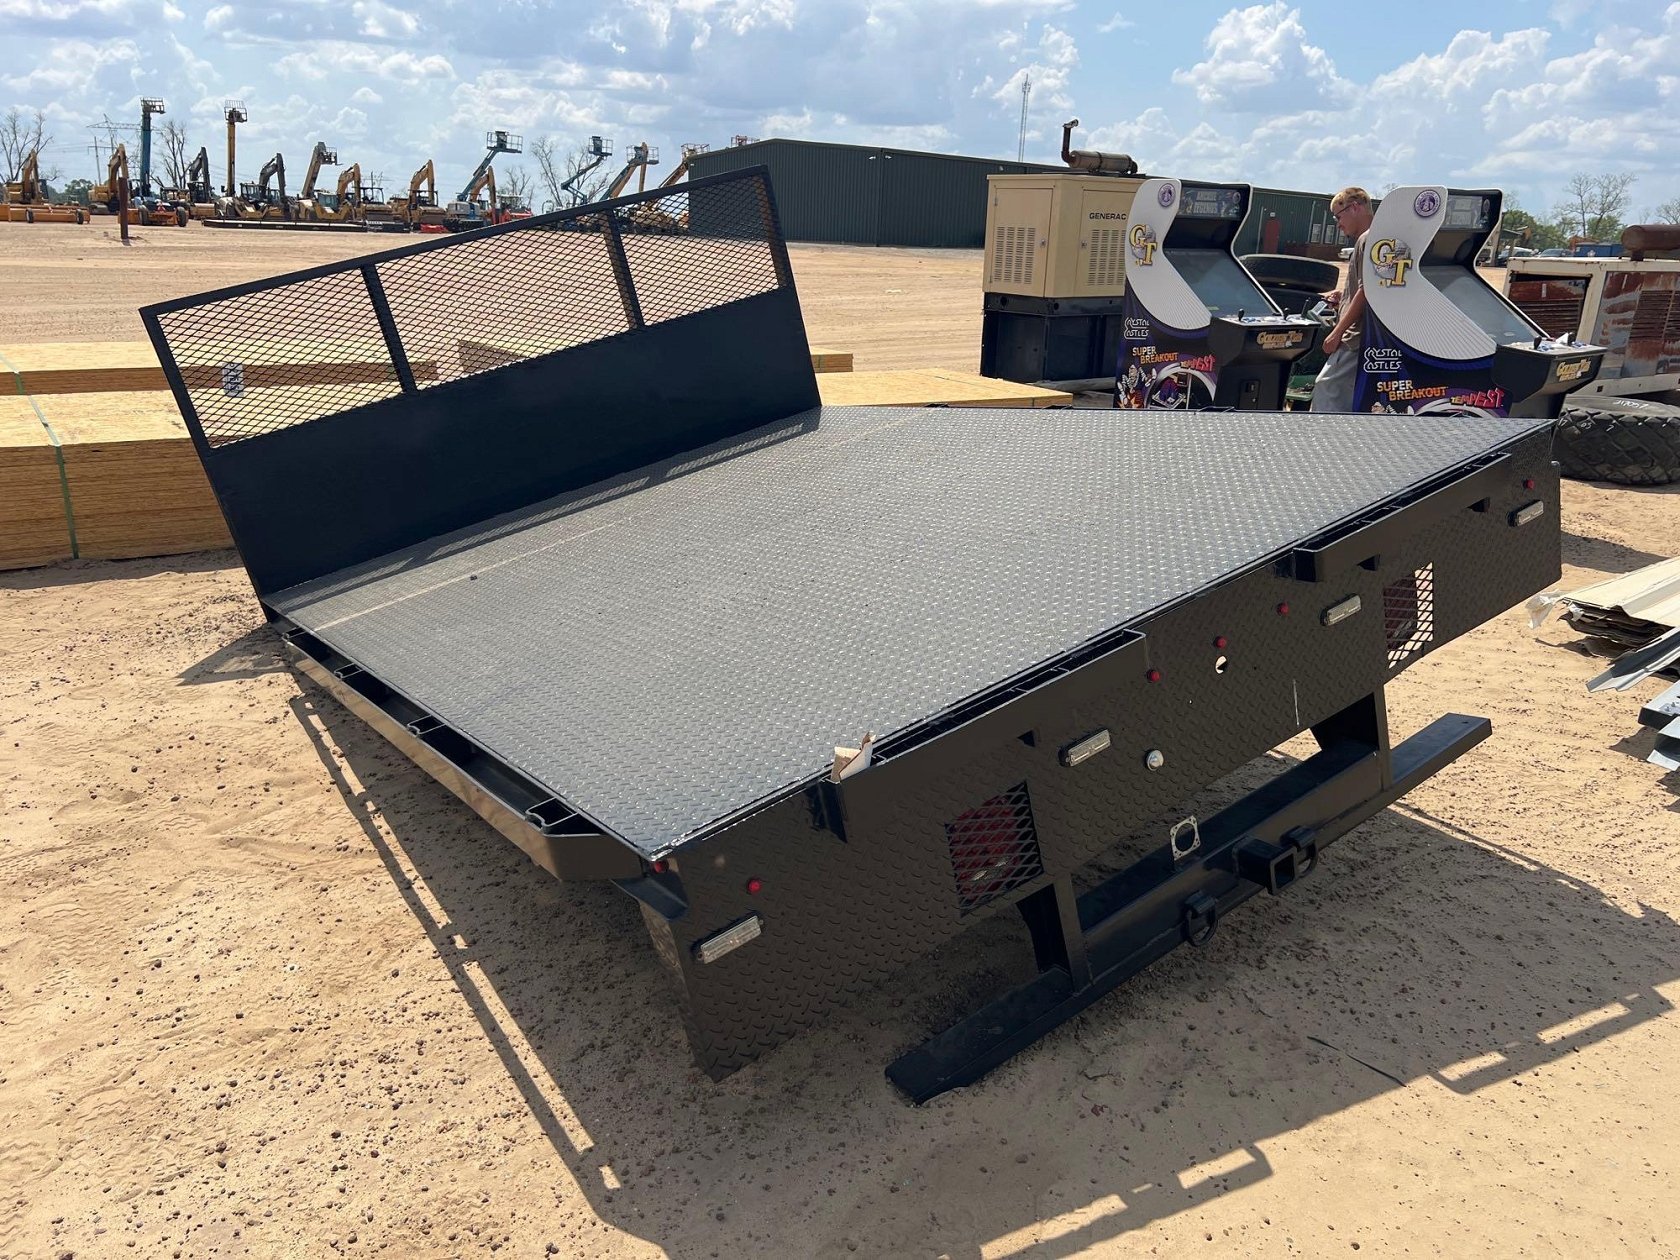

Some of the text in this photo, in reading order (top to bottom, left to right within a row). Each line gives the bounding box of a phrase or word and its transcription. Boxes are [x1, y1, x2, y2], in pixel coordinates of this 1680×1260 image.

[1089, 212, 1127, 220] GENERAC
[1132, 346, 1157, 356] SUPER
[1140, 352, 1179, 365] BREAKOUT
[1376, 379, 1414, 392] SUPER
[1388, 386, 1447, 402] BREAKOUT
[1450, 387, 1505, 408] TEMPEST
